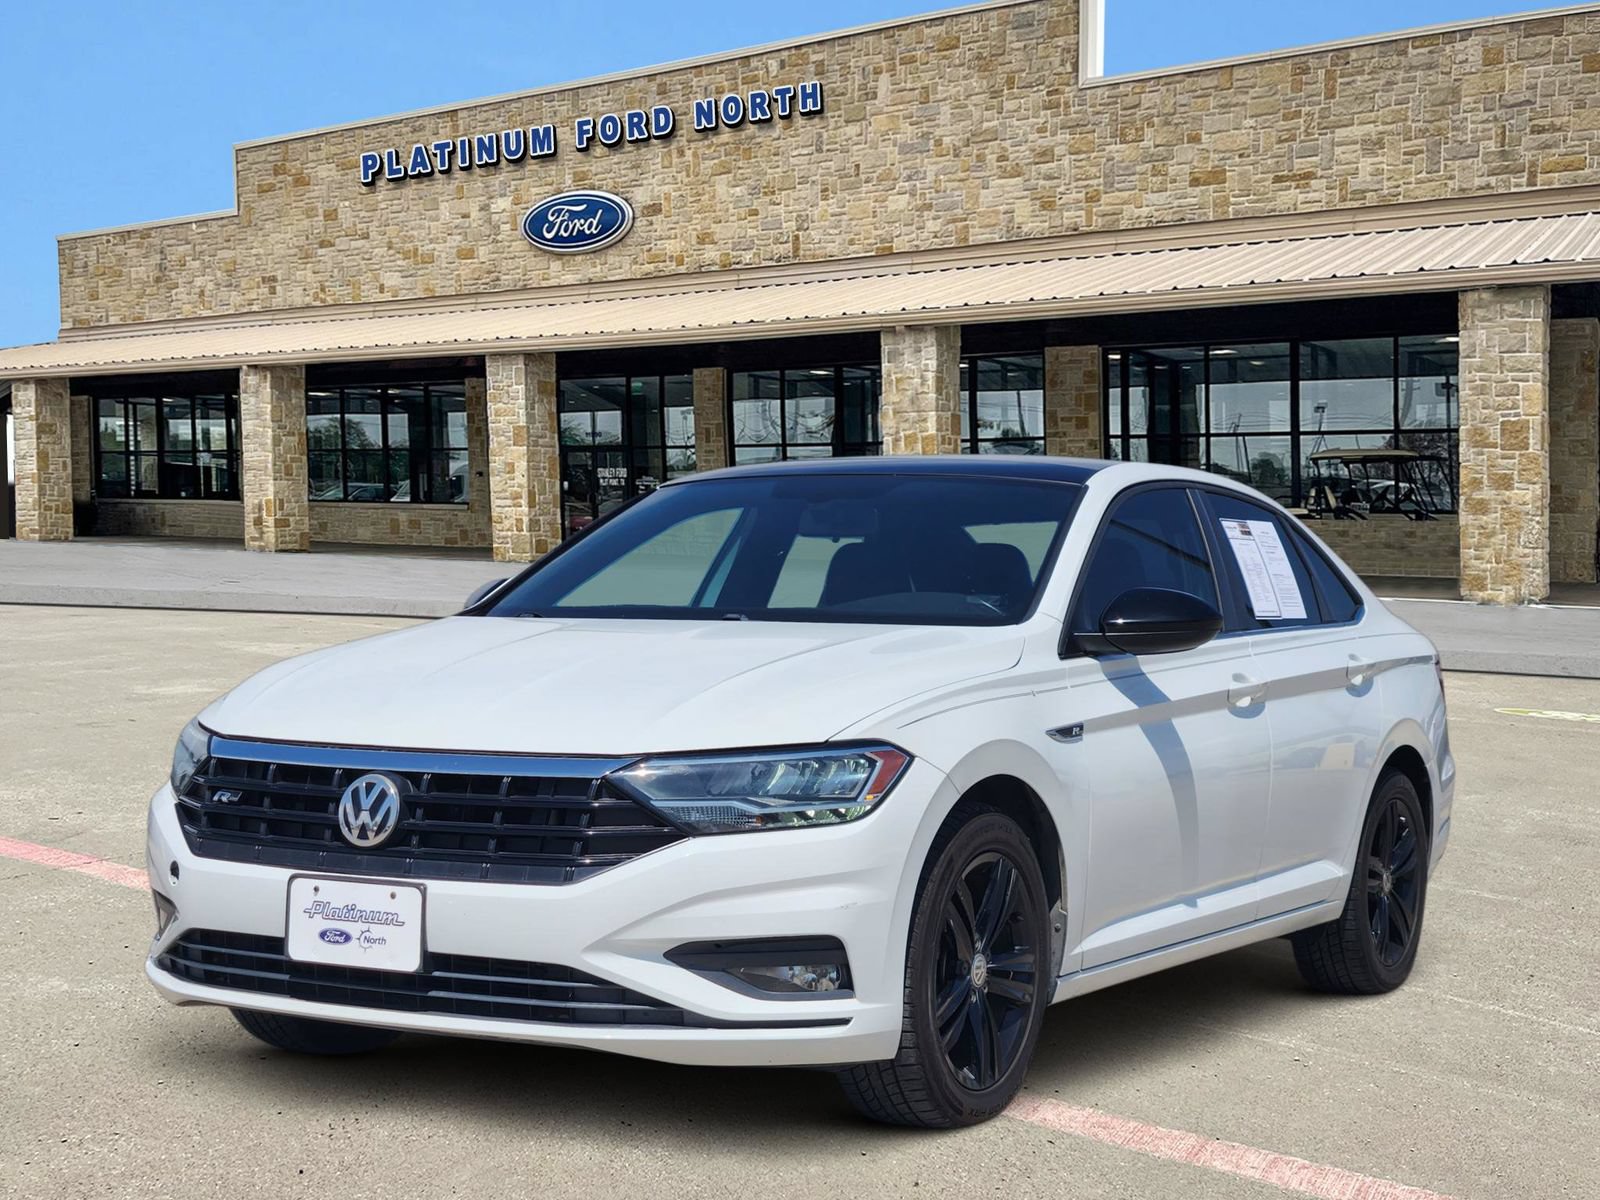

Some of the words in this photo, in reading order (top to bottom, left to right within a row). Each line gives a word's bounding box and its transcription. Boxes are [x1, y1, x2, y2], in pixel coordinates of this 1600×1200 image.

[360, 124, 556, 185] PLATINUM
[575, 105, 675, 151] FORD
[693, 81, 823, 131] NORTH
[542, 203, 603, 239] Ford
[303, 900, 405, 926] Platinum
[324, 930, 346, 944] Ford
[363, 935, 387, 945] North
